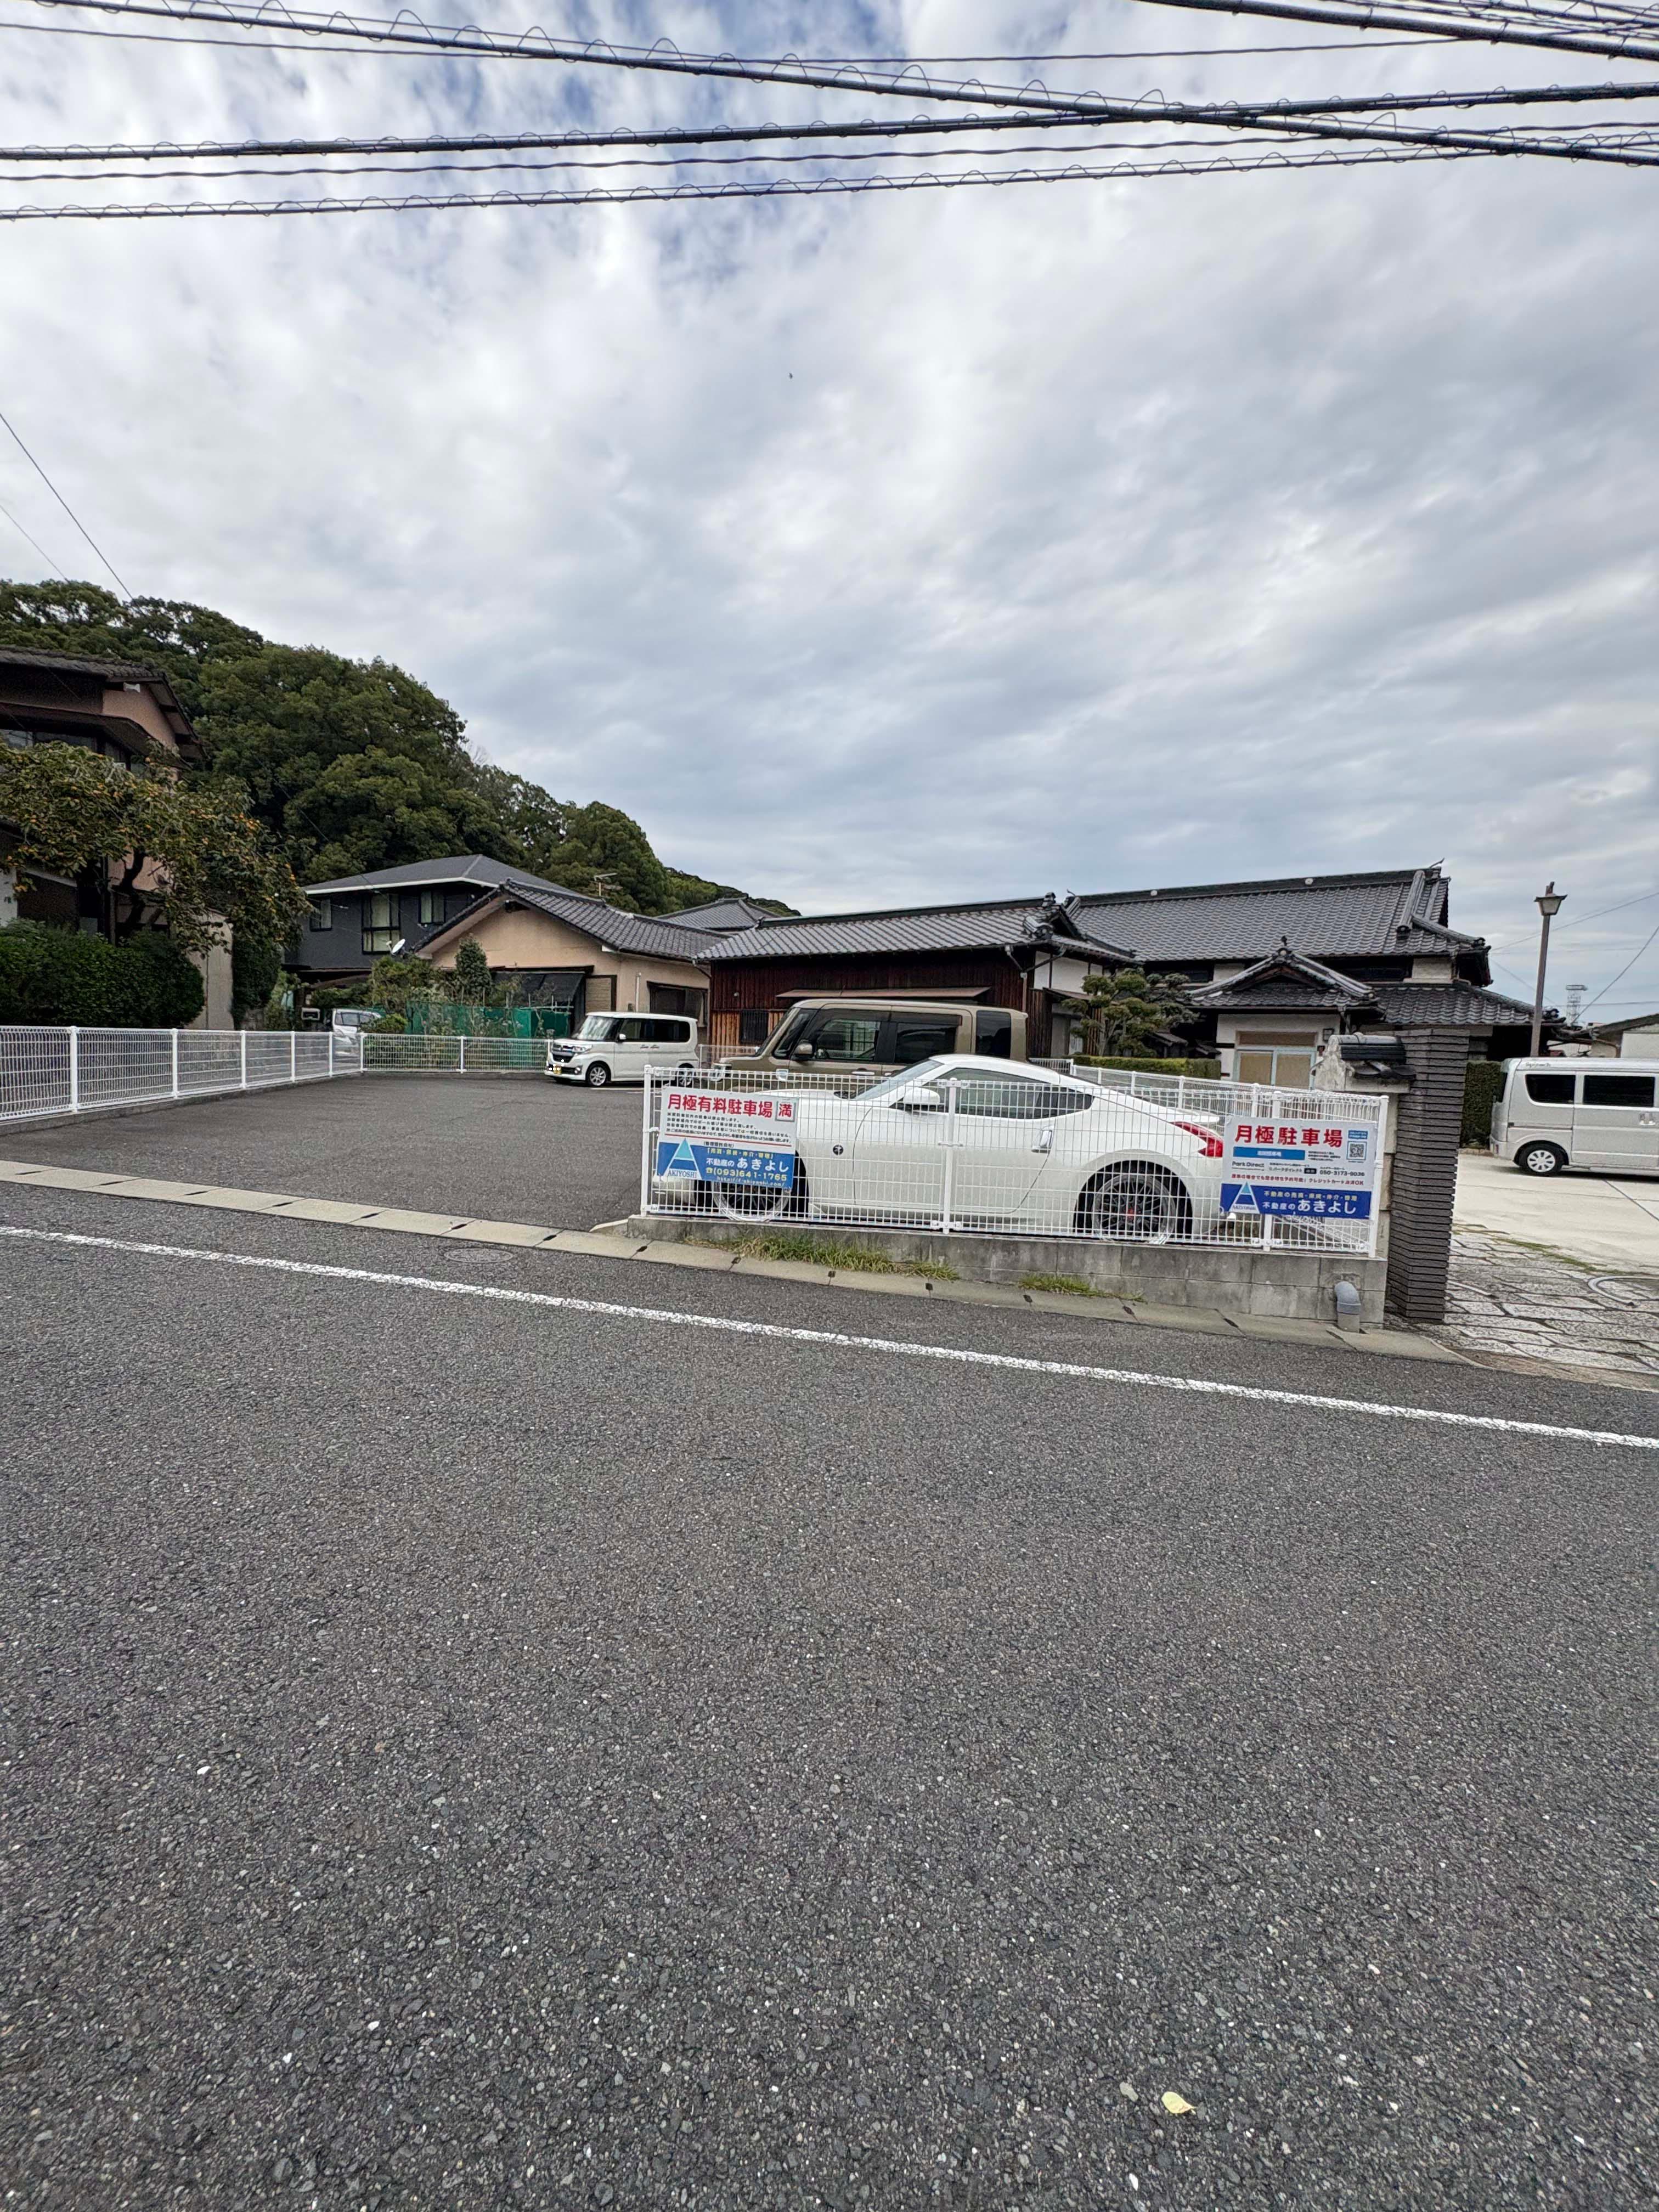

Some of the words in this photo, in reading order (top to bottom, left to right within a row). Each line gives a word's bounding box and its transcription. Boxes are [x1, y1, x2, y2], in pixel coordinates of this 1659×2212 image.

[668, 1094, 773, 1118] 月極有料駐車場
[778, 1103, 792, 1118] 満
[1235, 1125, 1343, 1148] 月極駐車場
[667, 1170, 697, 1178] AKIYOSHI
